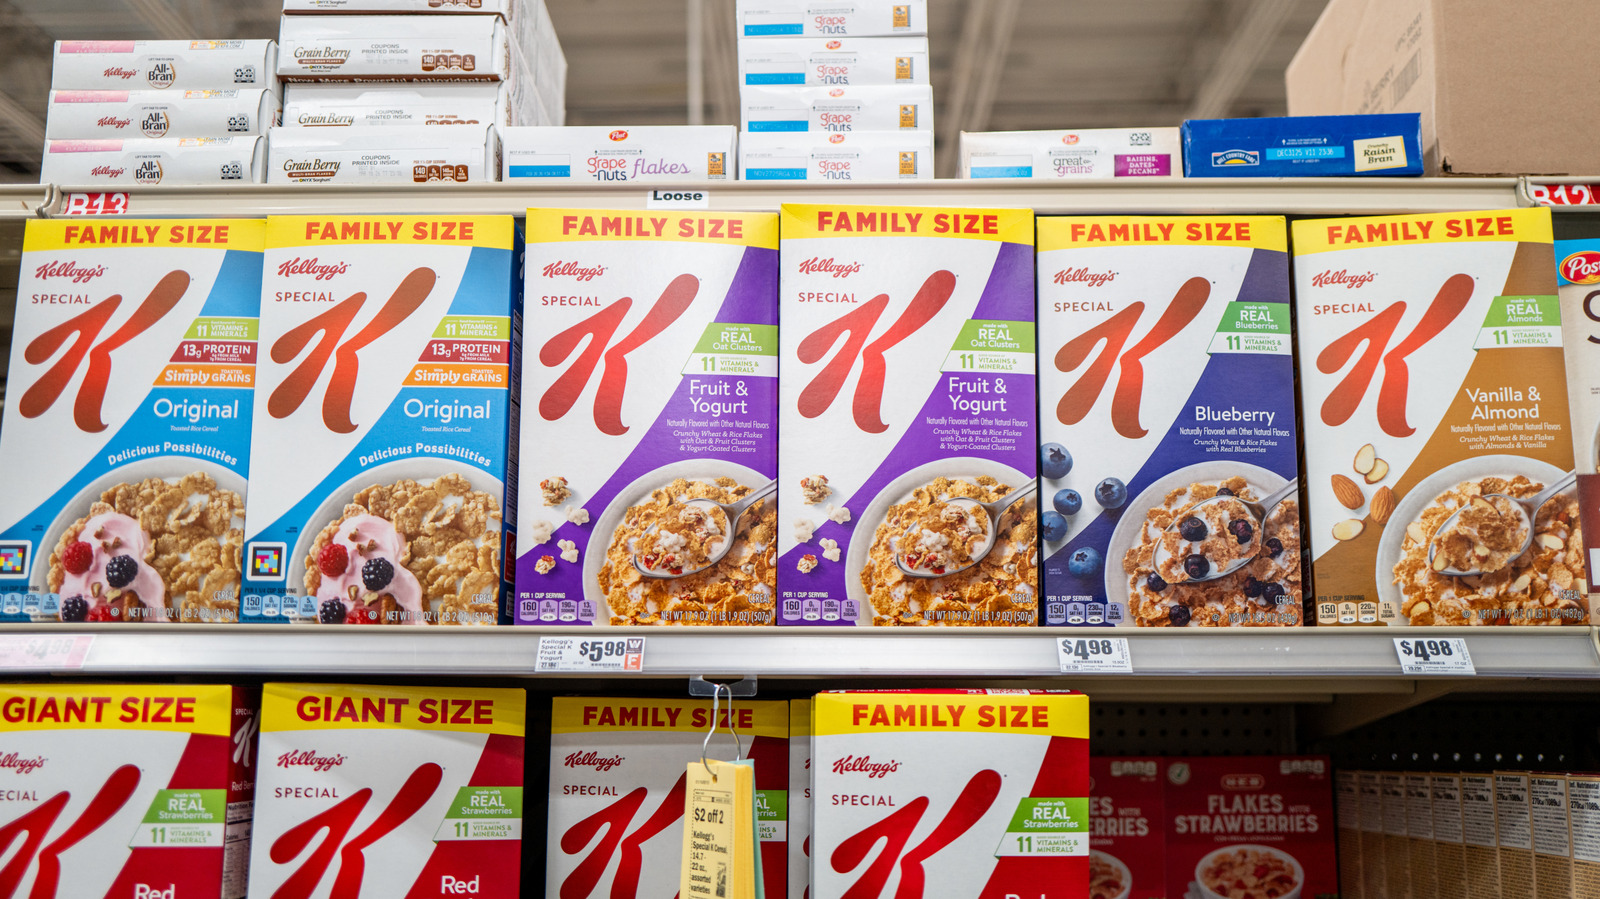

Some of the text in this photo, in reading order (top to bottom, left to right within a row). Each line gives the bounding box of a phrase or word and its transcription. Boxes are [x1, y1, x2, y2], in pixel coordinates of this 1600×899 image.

[815, 16, 846, 29] grape
[294, 46, 350, 59] Grain Berry
[104, 67, 138, 80] Kellogg's
[154, 63, 170, 74] All-
[816, 65, 848, 78] grape
[148, 72, 173, 81] Bran
[98, 116, 131, 128] Kellogg's
[298, 112, 354, 126] Grain Berry
[1363, 148, 1396, 157] Raisin
[1368, 154, 1394, 164] Bran
[141, 160, 157, 171] All-
[284, 158, 341, 172] Grain Berry
[587, 156, 626, 174] grape
[631, 158, 691, 178] flakes
[818, 160, 850, 174] grape
[1053, 157, 1083, 167] great
[91, 166, 124, 177] Kellogg's
[136, 168, 160, 179] Bran
[592, 170, 627, 181] -nuts
[1056, 164, 1092, 177] grains
[653, 190, 703, 200] Loose
[562, 216, 744, 239] FAMILY SIZE
[817, 211, 998, 234] FAMILY SIZE
[64, 226, 230, 244] FAMILY SIZE
[305, 222, 474, 240] FAMILY SIZE
[1070, 222, 1251, 242] FAMILY SIZE
[1327, 216, 1514, 245] FAMILY SIZE
[35, 260, 106, 284] Kellogg's
[278, 256, 348, 281] Kellogg's
[542, 260, 605, 282] Kellogg's
[798, 256, 862, 278] Kellogg's
[1054, 266, 1116, 288] Kellogg's
[1312, 268, 1376, 289] Kellogg's
[32, 294, 92, 304] SPECIAL
[275, 292, 336, 302] SPECIAL
[542, 296, 602, 306] SPECIAL
[798, 292, 858, 304] SPECIAL
[1054, 302, 1114, 313] SPECIAL
[1313, 302, 1375, 315] SPECIAL
[1506, 304, 1543, 315] REAL
[1240, 310, 1274, 322] REAL
[1507, 314, 1543, 323] Almonds
[1235, 321, 1279, 330] Blueberries
[720, 332, 756, 344] REAL
[978, 329, 1013, 340] REAL
[453, 344, 501, 354] PROTEIN
[712, 343, 762, 352] Oat Clusters
[960, 354, 974, 369] 11
[414, 369, 502, 384] Simply GRAINS
[690, 379, 748, 396] Fruit &
[949, 377, 1008, 393] Fruit &
[1466, 386, 1541, 402] Vanilla &
[154, 398, 238, 422] Original
[404, 398, 490, 423] Original
[689, 397, 748, 418] Yogurt
[948, 395, 1008, 415] Yogurt
[1471, 404, 1539, 420] Almond
[1195, 406, 1276, 426] Blueberry
[673, 430, 700, 439] Crunchy
[743, 431, 763, 439] Flakes
[108, 442, 238, 466] Delicious Possibilities
[359, 443, 491, 467] Delicious Possibilities
[2, 697, 196, 723] GIANT SIZE
[296, 696, 494, 725] GIANT SIZE
[583, 706, 682, 727] FAMILY
[853, 704, 1049, 728] FAMILY SIZE
[277, 749, 344, 772] Kellogg's
[564, 750, 624, 772] Kellogg's
[832, 754, 899, 778] Kellogg's
[275, 787, 339, 799] SPECIAL
[563, 785, 618, 796] SPECIAL
[470, 795, 505, 807] REAL
[832, 795, 895, 806] SPECIAL
[1207, 794, 1283, 814] FLAKES
[461, 807, 513, 815] Strawberries
[695, 808, 724, 824] $2 off 2
[1033, 808, 1071, 820] REAL
[1024, 819, 1079, 829] Strawberries
[1175, 814, 1319, 834] STRAWBERRIES
[441, 875, 479, 894] Red
